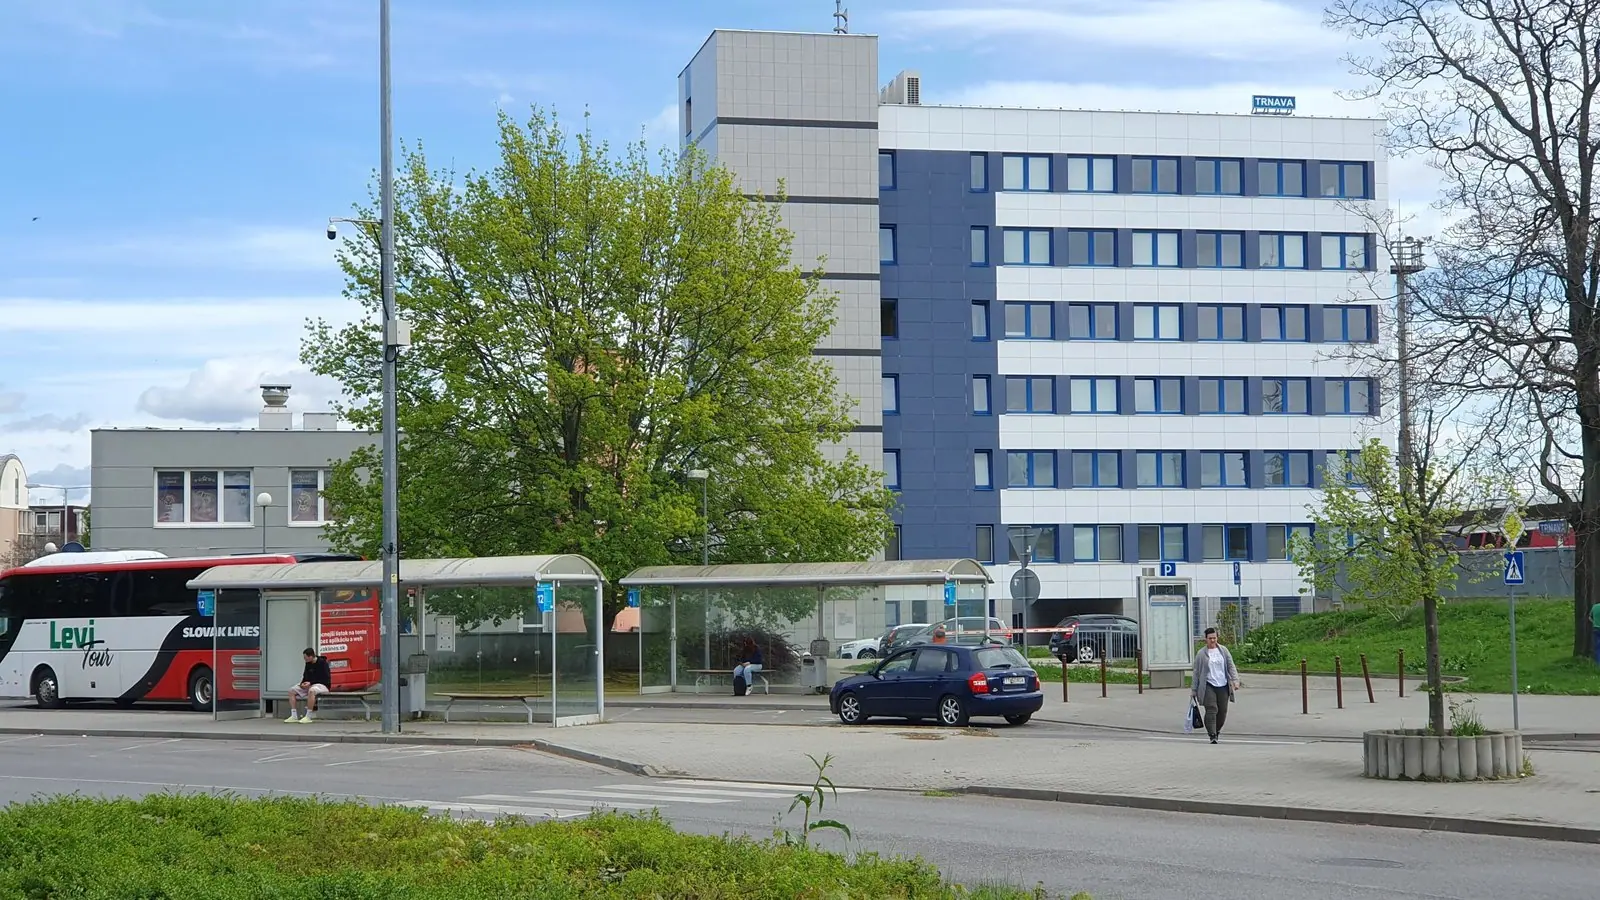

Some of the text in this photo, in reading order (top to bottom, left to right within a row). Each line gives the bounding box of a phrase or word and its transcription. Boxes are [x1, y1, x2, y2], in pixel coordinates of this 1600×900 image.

[1254, 97, 1293, 107] TRNAVA
[1164, 564, 1172, 576] P
[198, 600, 205, 609] 12
[537, 595, 544, 604] 12
[50, 619, 95, 649] Levi
[183, 626, 260, 638] SLOVAK LINES
[80, 640, 114, 670] Tour
